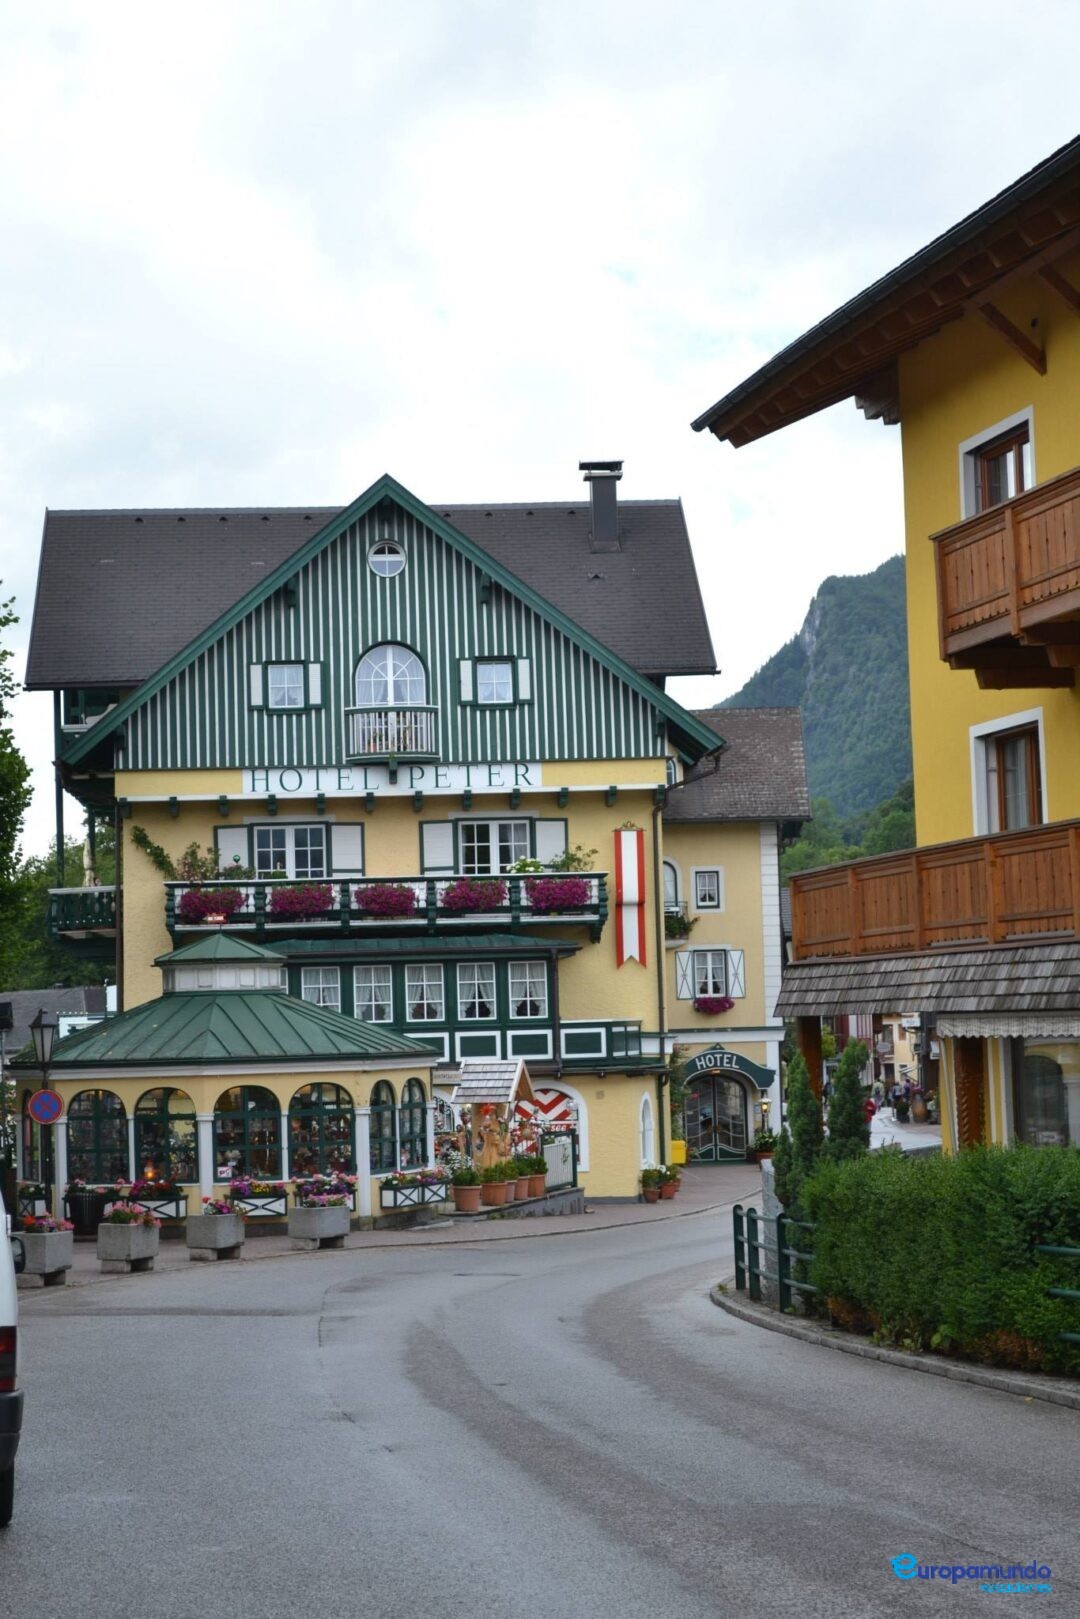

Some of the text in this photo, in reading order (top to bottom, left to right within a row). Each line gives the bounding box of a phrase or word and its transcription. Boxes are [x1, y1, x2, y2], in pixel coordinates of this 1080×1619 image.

[251, 762, 533, 792] HOTEL PETER
[695, 1053, 740, 1071] HOTEL
